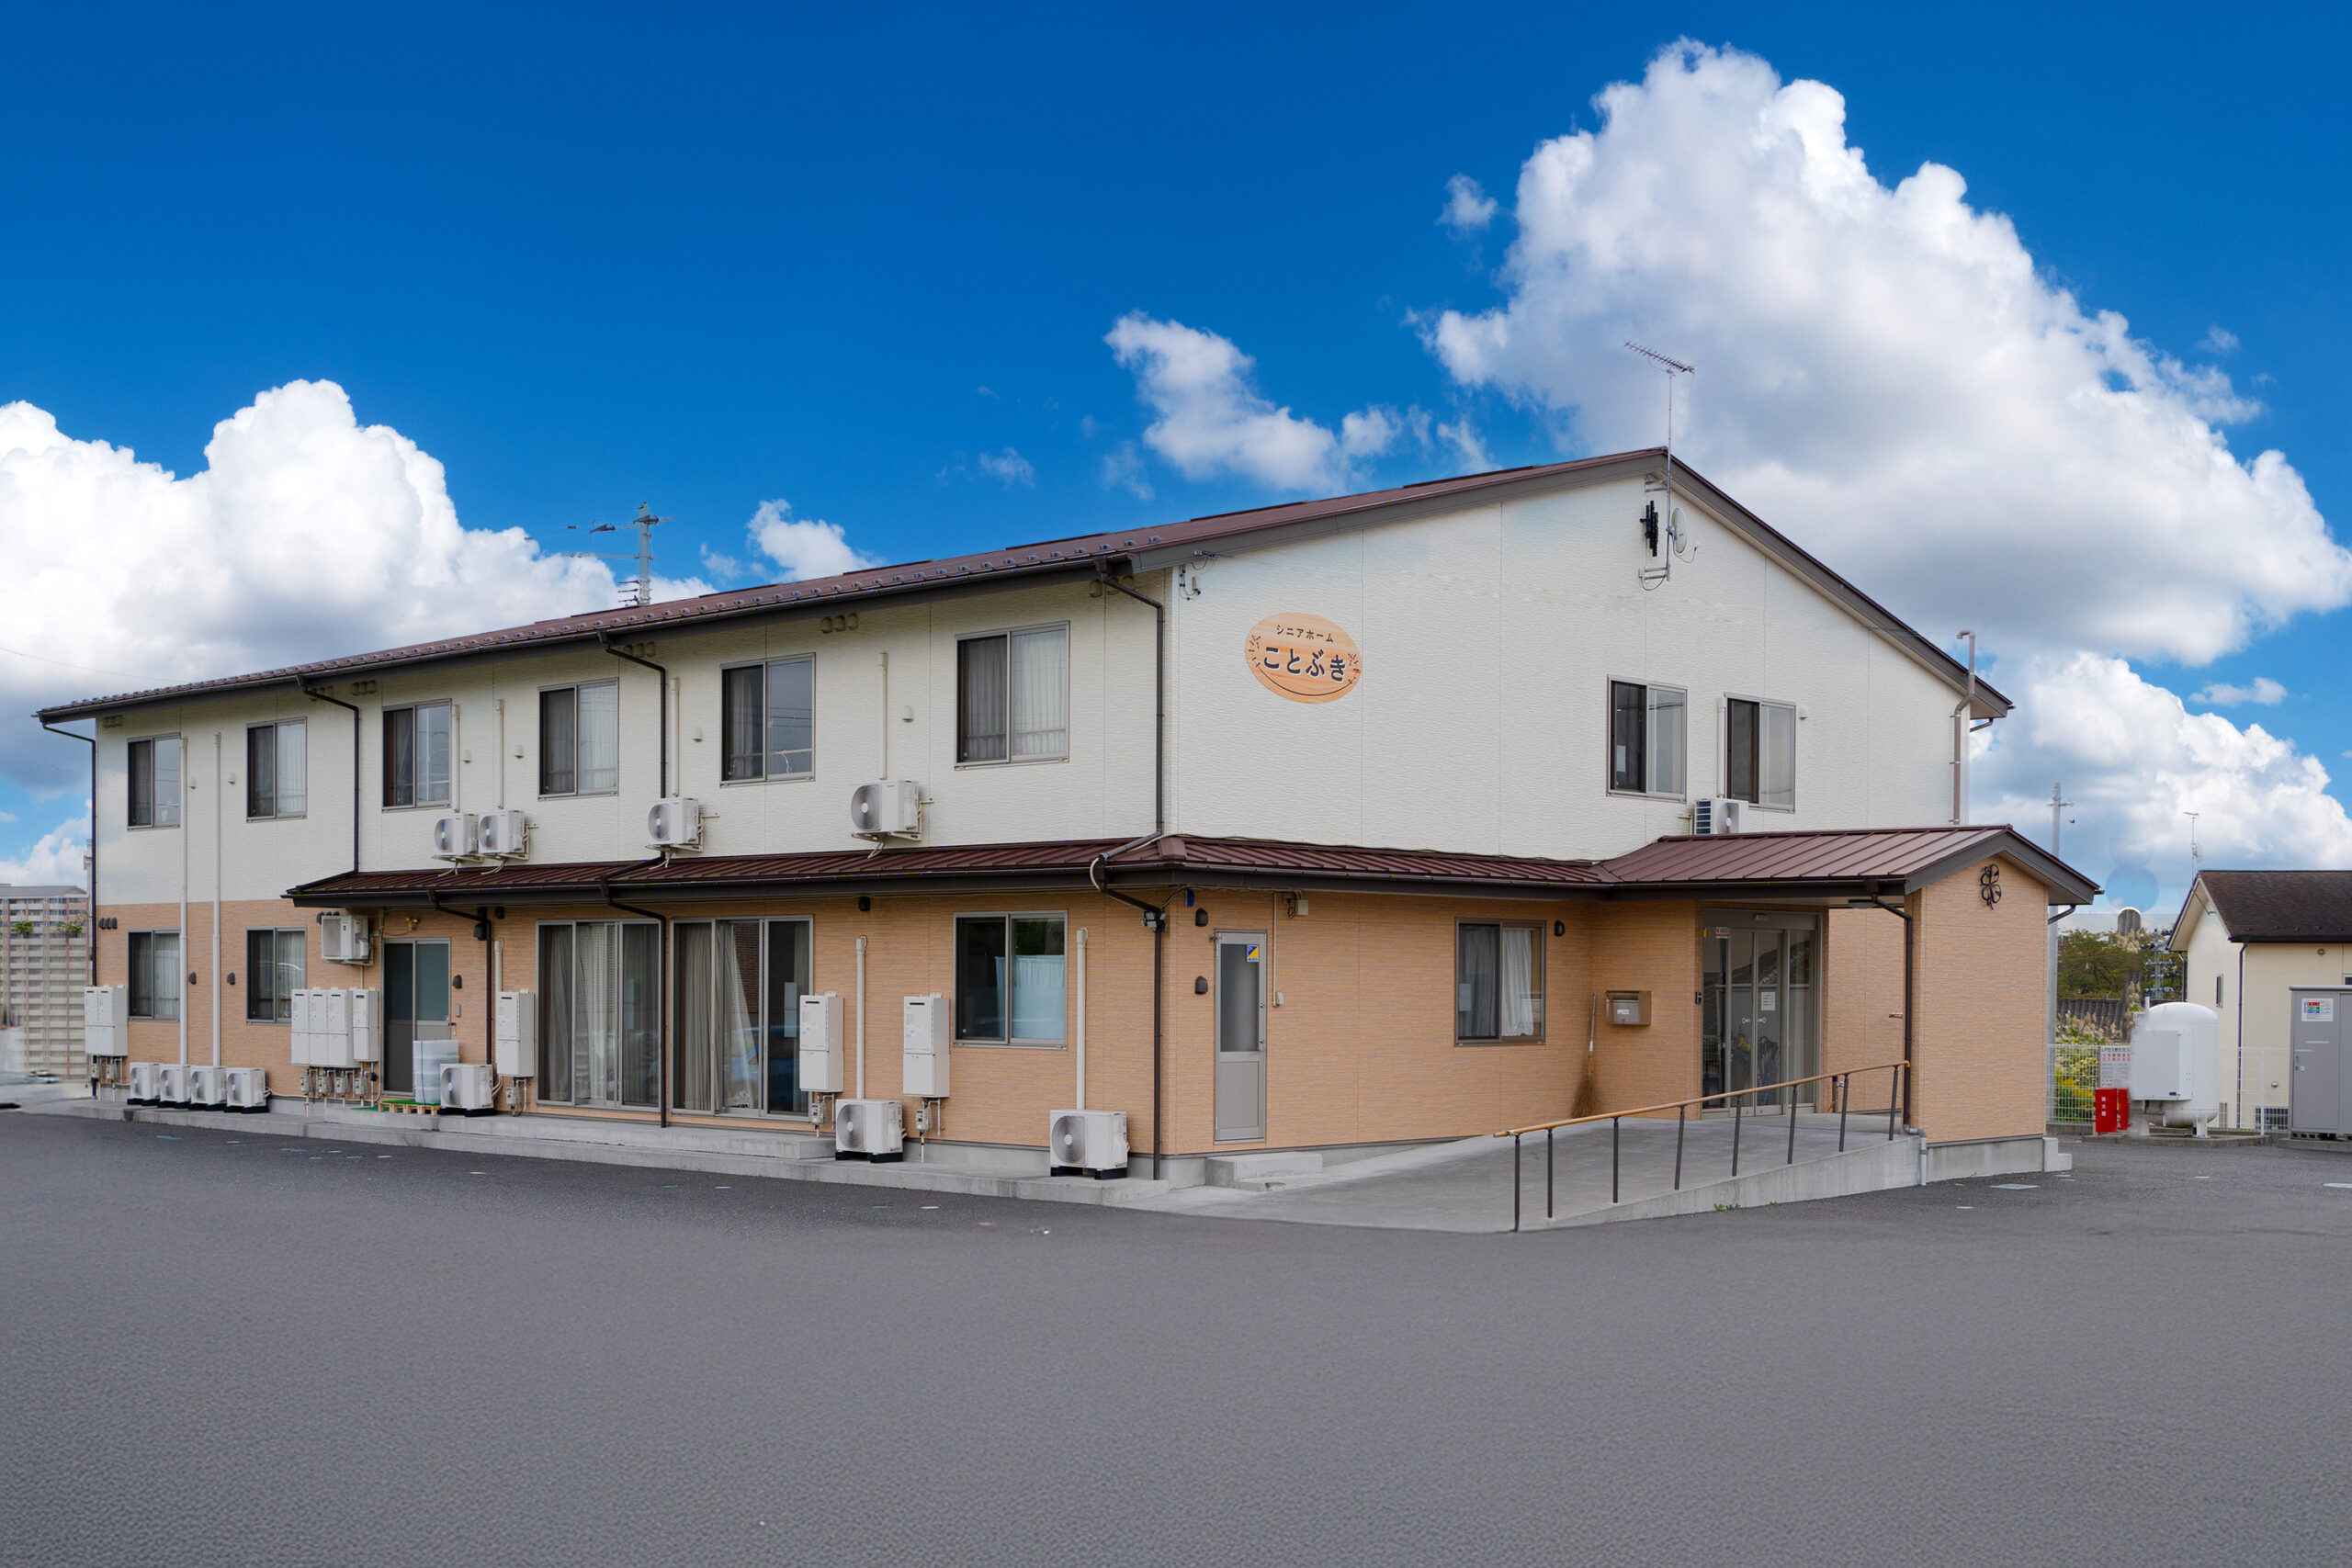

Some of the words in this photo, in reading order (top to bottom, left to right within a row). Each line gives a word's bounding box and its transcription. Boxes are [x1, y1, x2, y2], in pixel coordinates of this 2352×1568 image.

[1275, 625, 1334, 644] シニアホーム
[1263, 646, 1346, 682] ことぶき
